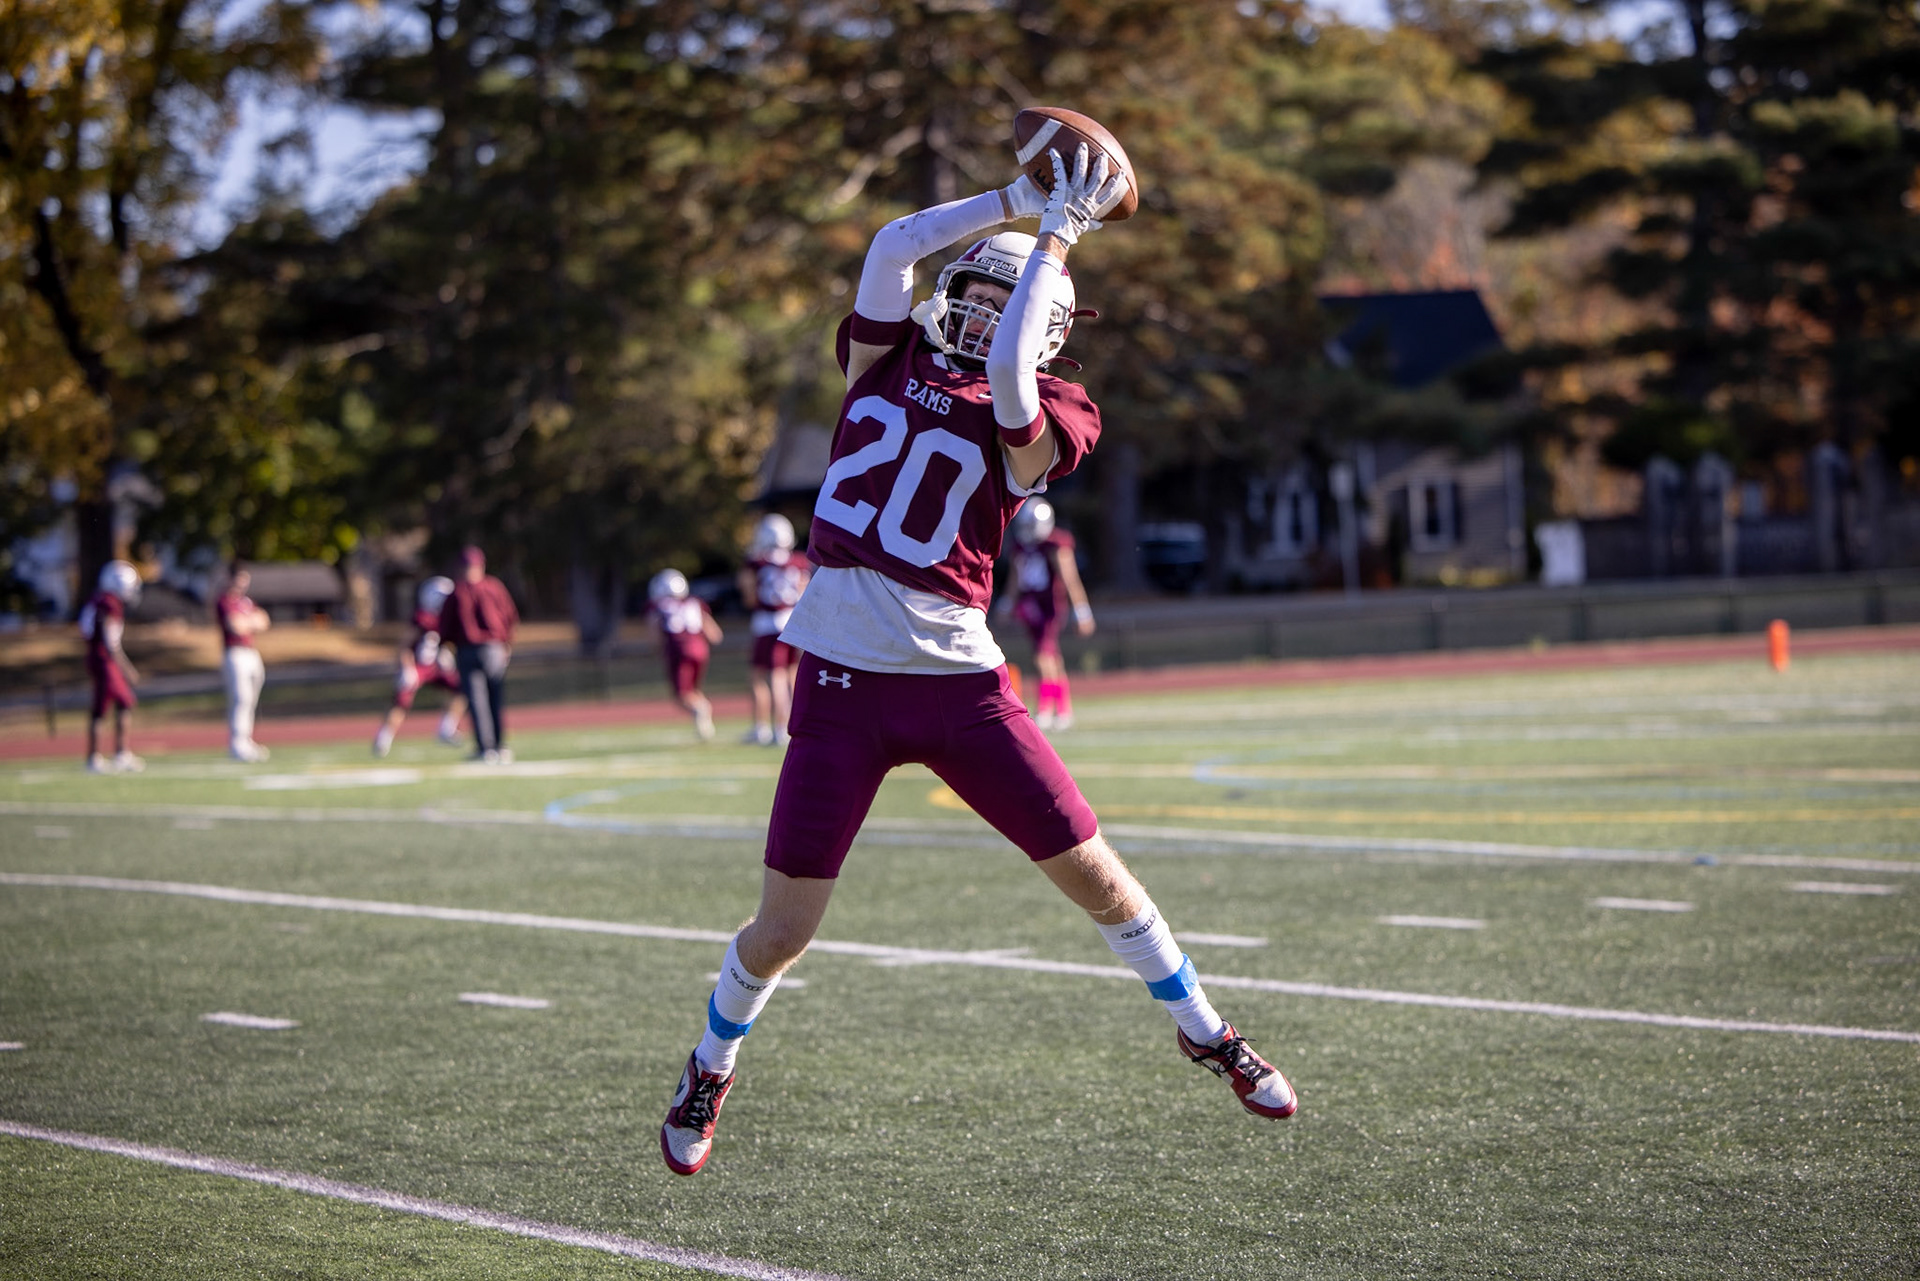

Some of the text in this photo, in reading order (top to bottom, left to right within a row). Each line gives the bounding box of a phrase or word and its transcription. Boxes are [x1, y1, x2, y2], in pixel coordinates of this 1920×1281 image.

[980, 256, 1016, 273] Riddell
[904, 378, 952, 416] RAMS
[814, 395, 987, 569] 20
